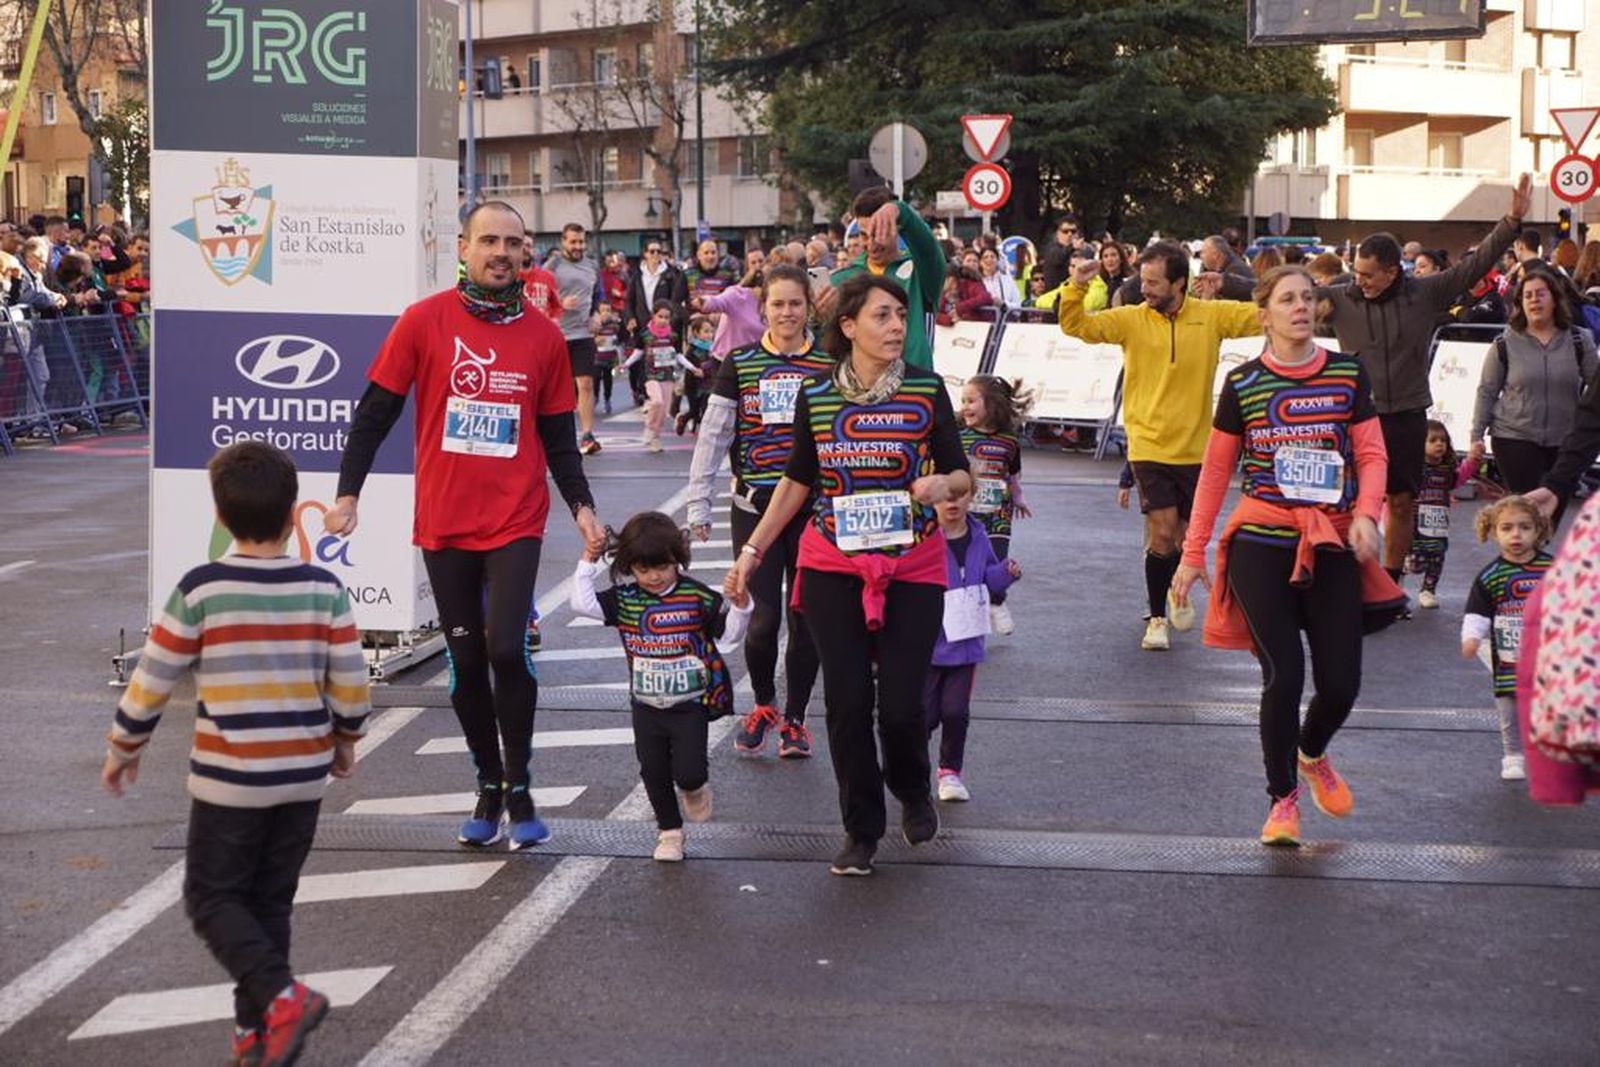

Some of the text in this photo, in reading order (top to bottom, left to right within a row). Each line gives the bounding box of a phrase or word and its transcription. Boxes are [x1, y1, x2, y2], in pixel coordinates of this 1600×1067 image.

[312, 102, 367, 113] SOLUCIONES
[324, 115, 331, 123] A
[333, 114, 367, 125] MEDIDA
[974, 179, 999, 195] 30
[1562, 170, 1589, 186] 30
[279, 216, 406, 236] San Estanislao
[280, 235, 365, 255] de Kostka
[212, 396, 359, 423] HYUNDA
[857, 414, 904, 425] XXXVIII
[456, 415, 500, 439] 2140
[1272, 423, 1335, 437] SILVESTRE
[211, 424, 349, 451] Gestoraut
[835, 441, 904, 454] SILVESTRE
[1282, 461, 1326, 484] 3500
[846, 508, 894, 532] 5202
[642, 671, 689, 694] 6079
